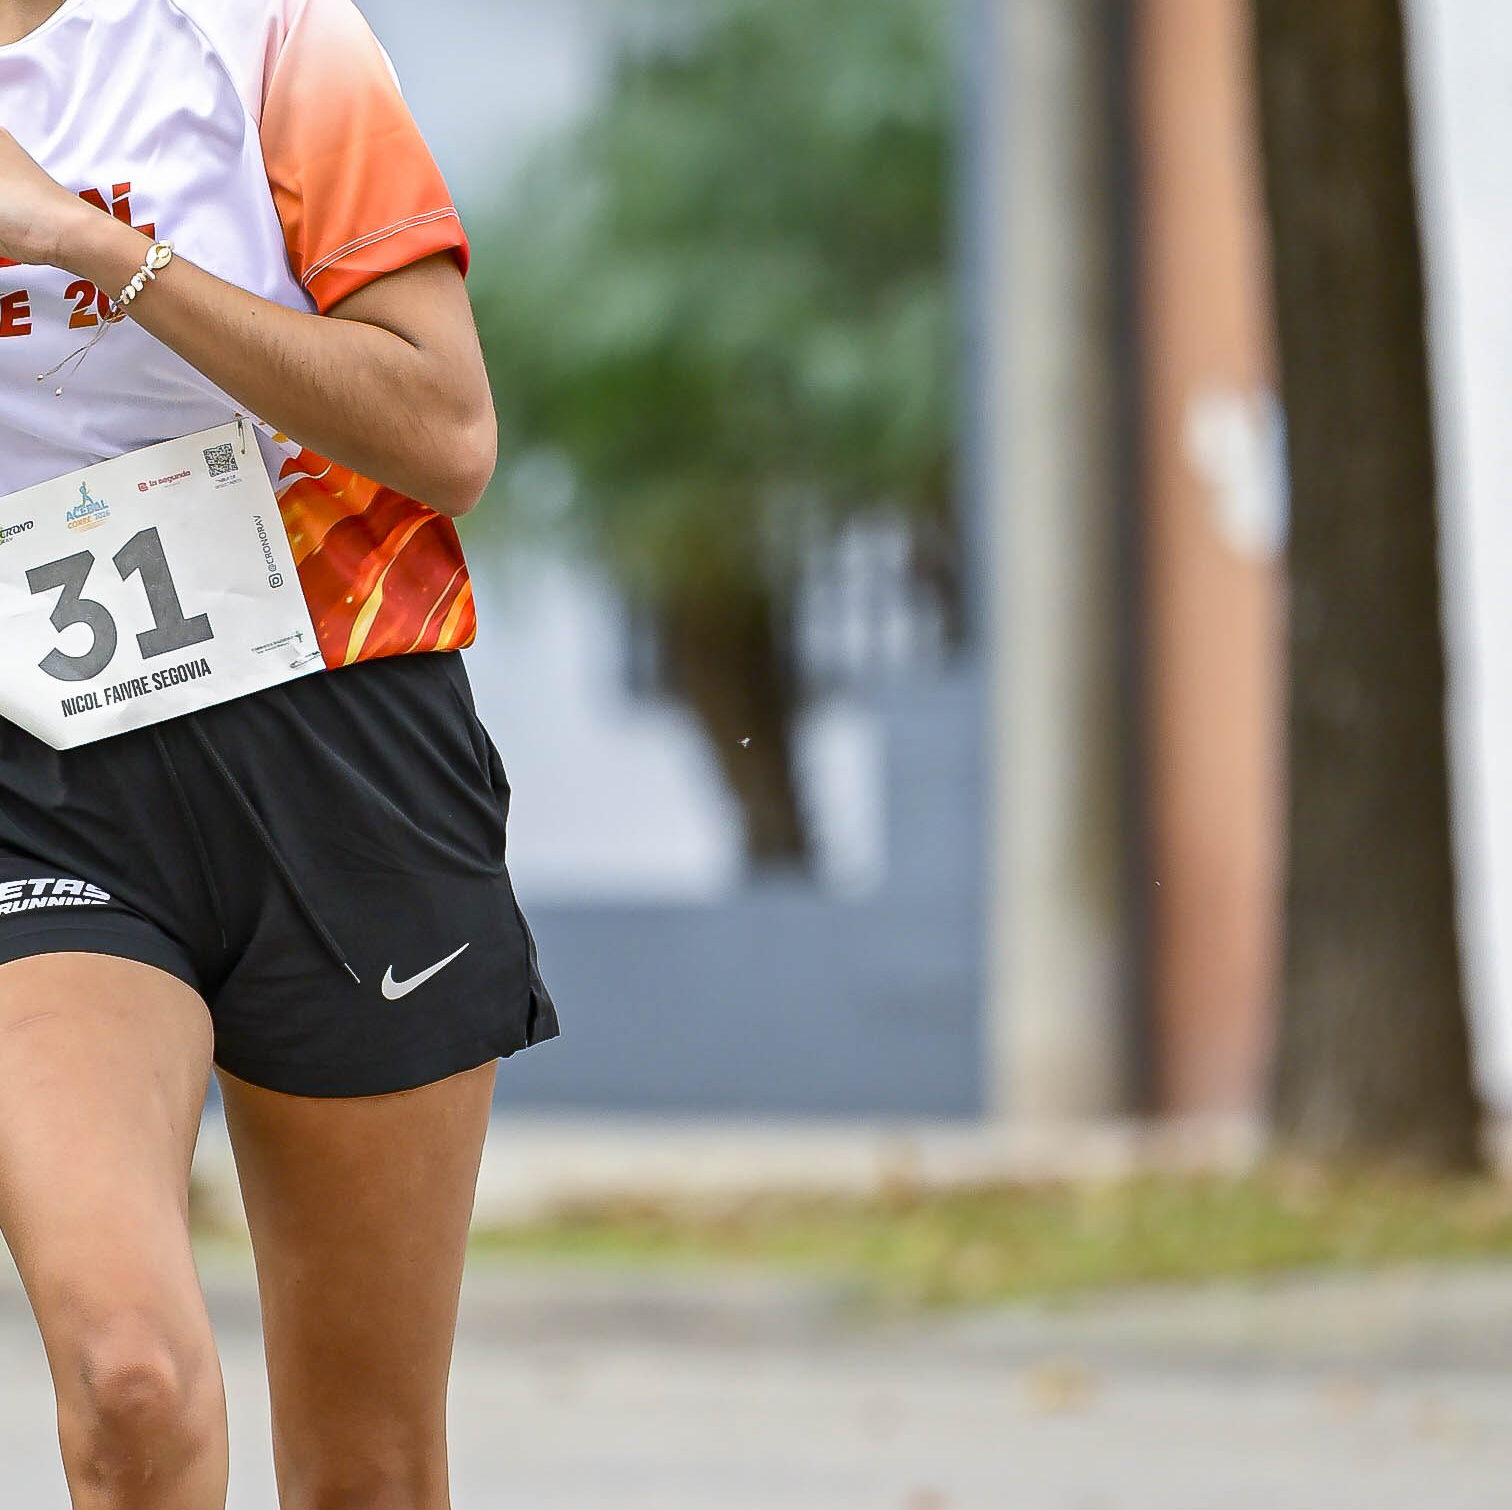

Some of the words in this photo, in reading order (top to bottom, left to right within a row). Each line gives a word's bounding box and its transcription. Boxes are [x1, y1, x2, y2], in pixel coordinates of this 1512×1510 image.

[63, 278, 128, 331] 20
[66, 499, 109, 522] ACEBAL
[252, 515, 277, 572] @CRONORAV
[25, 526, 214, 682] 31
[61, 691, 103, 717] NICOL
[103, 675, 153, 706] FAIVRE
[151, 657, 212, 691] SEGOVIA
